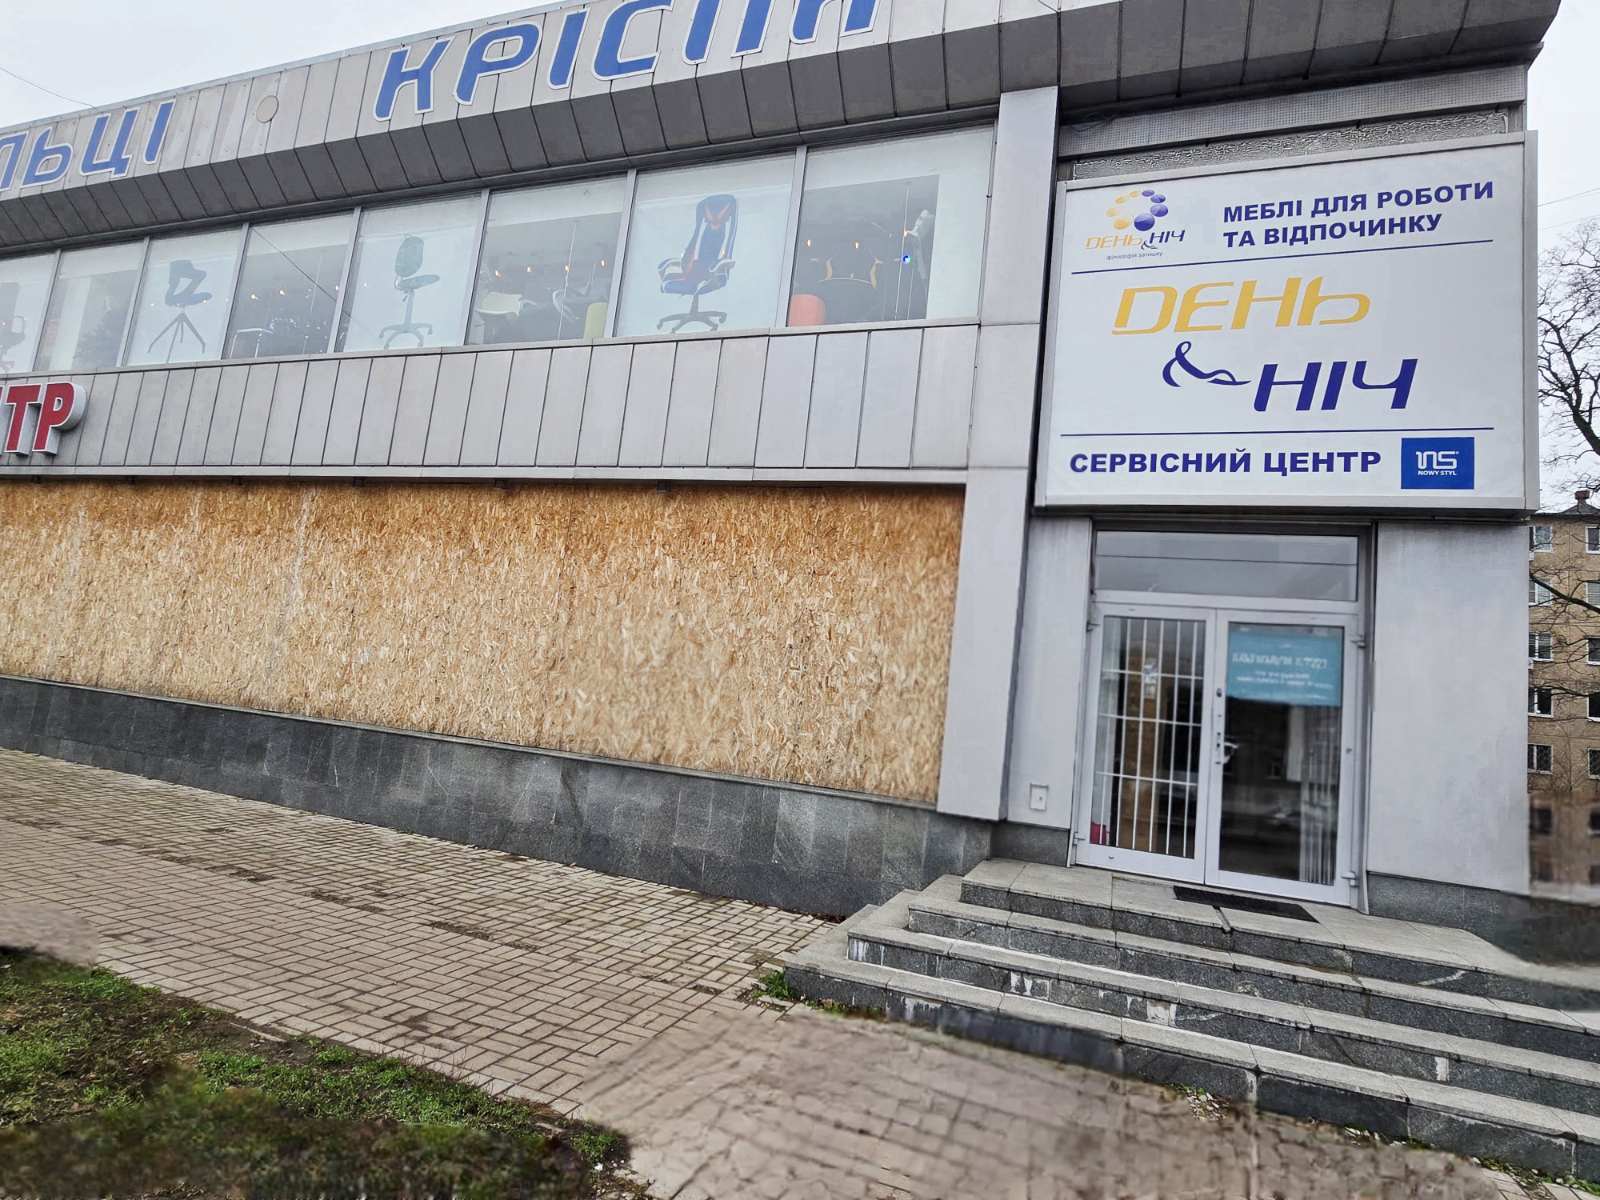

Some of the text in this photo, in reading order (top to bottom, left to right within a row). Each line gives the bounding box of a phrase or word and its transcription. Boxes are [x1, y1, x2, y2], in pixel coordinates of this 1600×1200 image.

[1223, 181, 1493, 223] МЕБЛІ ДЛЯ РОБОТИ
[1223, 213, 1443, 248] ТА ВІДПОЧИНКУ
[1253, 358, 1419, 412] НІЧ
[0, 381, 82, 454] ТР
[1069, 447, 1382, 477] СЕРВІСНИЙ ЦЕНТР
